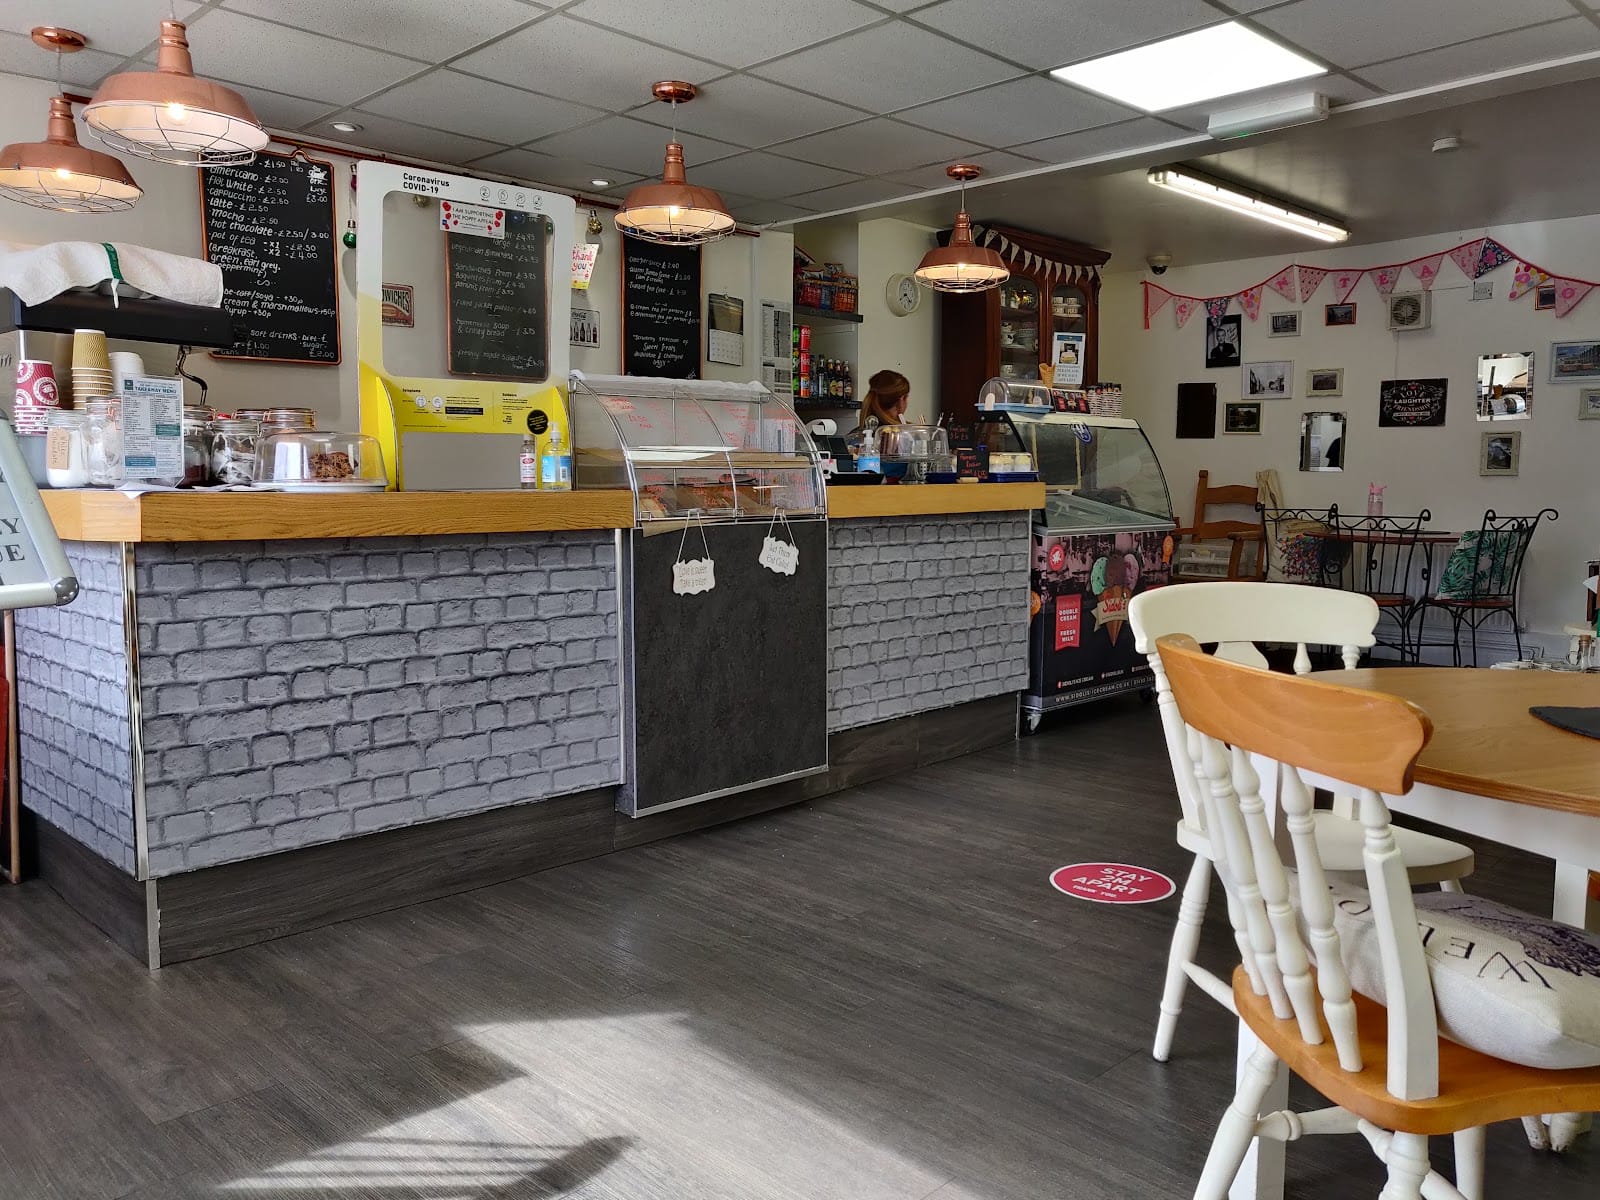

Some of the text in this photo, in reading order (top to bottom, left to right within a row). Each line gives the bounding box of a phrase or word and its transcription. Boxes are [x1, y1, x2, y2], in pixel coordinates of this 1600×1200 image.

[209, 166, 259, 181] americano
[403, 173, 450, 187] Coronavirus
[208, 175, 225, 188] flat
[226, 179, 254, 192] white
[403, 181, 439, 194] COVID-19
[209, 187, 257, 203] cappuccino
[211, 208, 245, 222] mocha
[211, 219, 227, 230] hot
[229, 221, 273, 237] chocolate
[210, 232, 226, 242] pot
[229, 234, 240, 246] of
[572, 250, 592, 261] thank
[572, 261, 587, 271] you
[223, 297, 249, 308] cream
[269, 330, 298, 341] drinks
[1059, 607, 1079, 616] DOUBLE
[1059, 614, 1077, 622] CREAM
[1060, 629, 1076, 638] FRESH
[1100, 867, 1153, 882] STAY
[1100, 875, 1132, 886] 2M
[1071, 876, 1143, 895] APART
[1072, 885, 1098, 893] THANK
